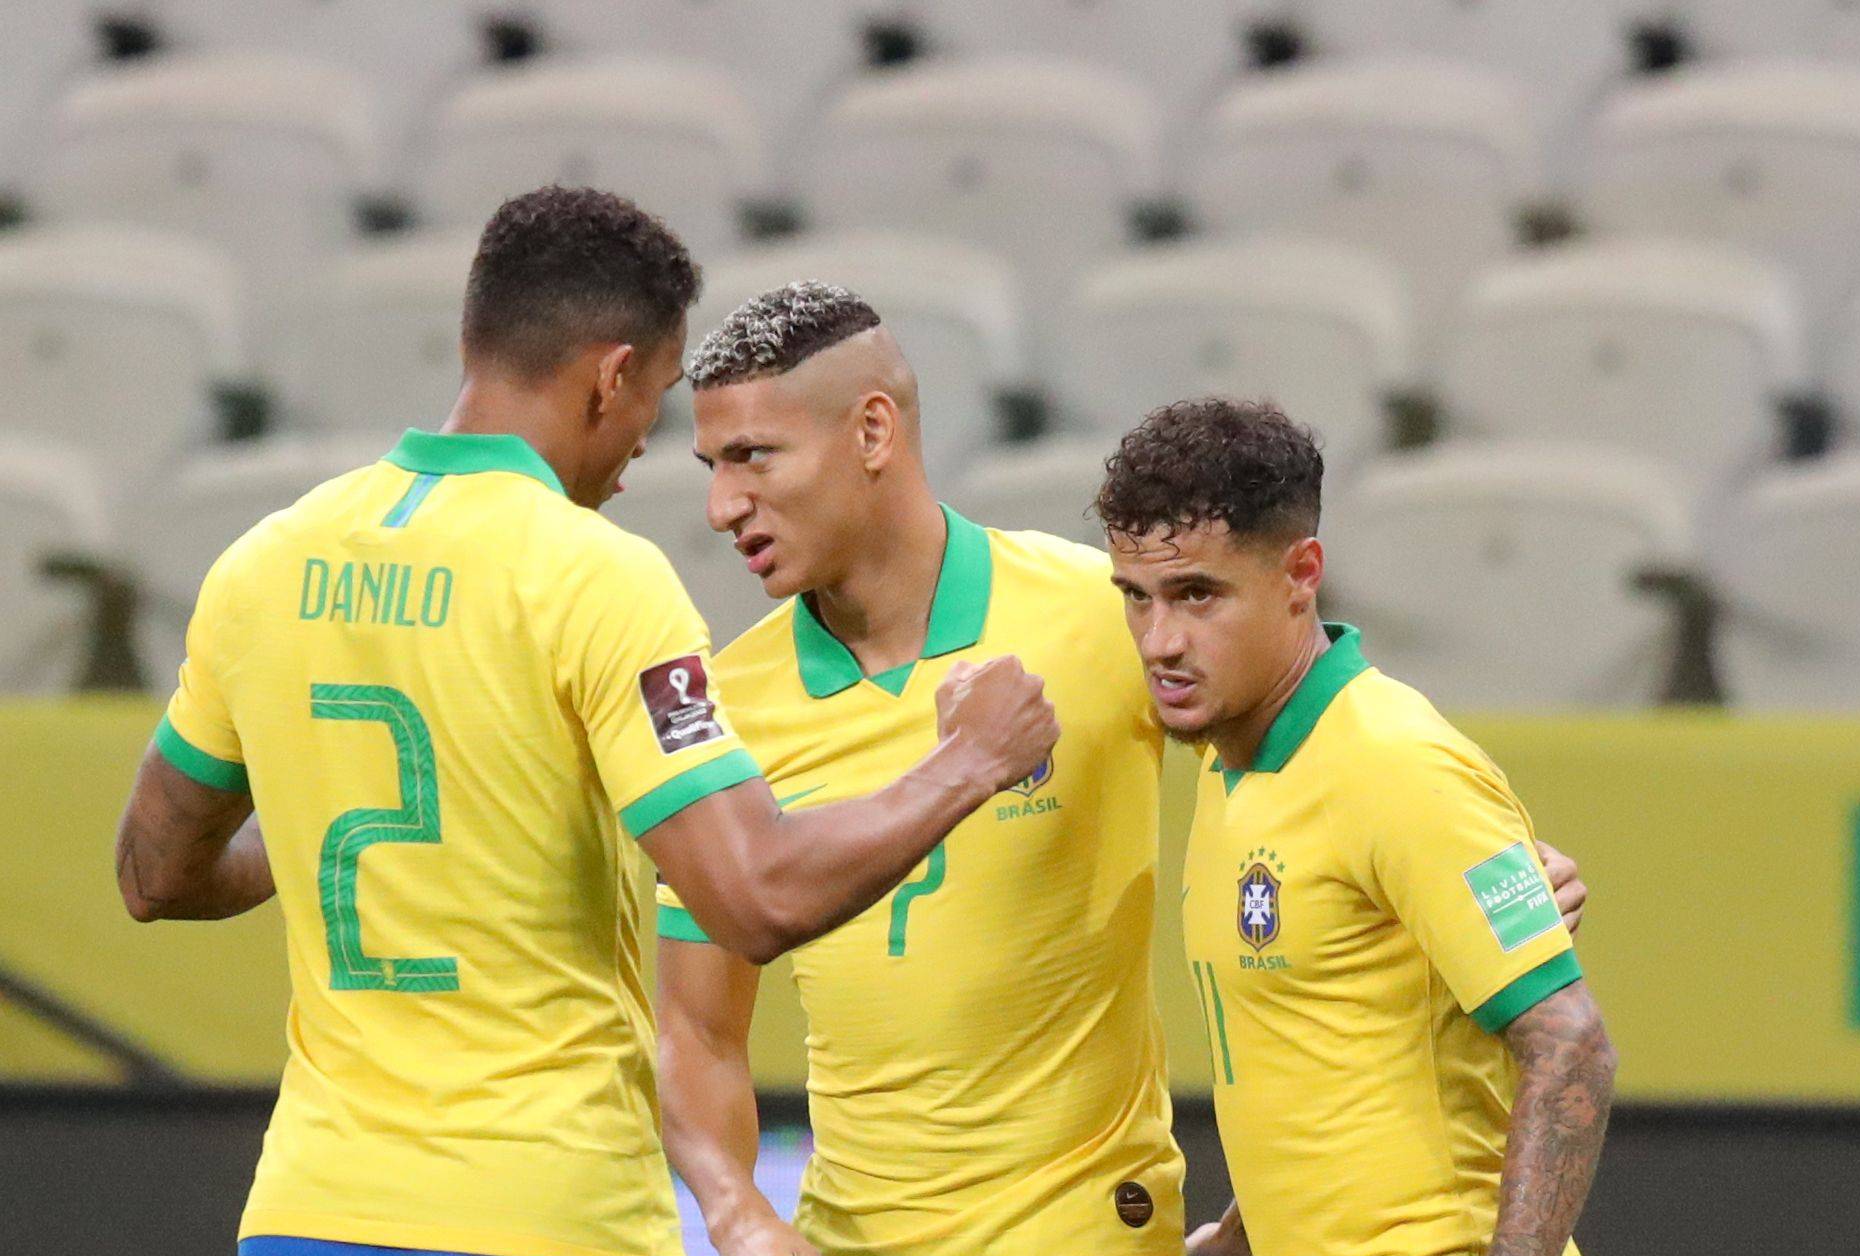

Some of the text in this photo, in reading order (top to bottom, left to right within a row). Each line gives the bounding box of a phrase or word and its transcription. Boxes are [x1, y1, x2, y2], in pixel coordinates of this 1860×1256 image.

[299, 558, 453, 628] DANILO
[996, 796, 1062, 821] BRASIL
[310, 683, 460, 992] 2
[1481, 864, 1536, 901] LIVING
[1486, 874, 1541, 908] FOOTBALL
[1249, 899, 1265, 910] CBF
[1527, 891, 1549, 910] FIFA
[1239, 953, 1292, 970] BRASIL
